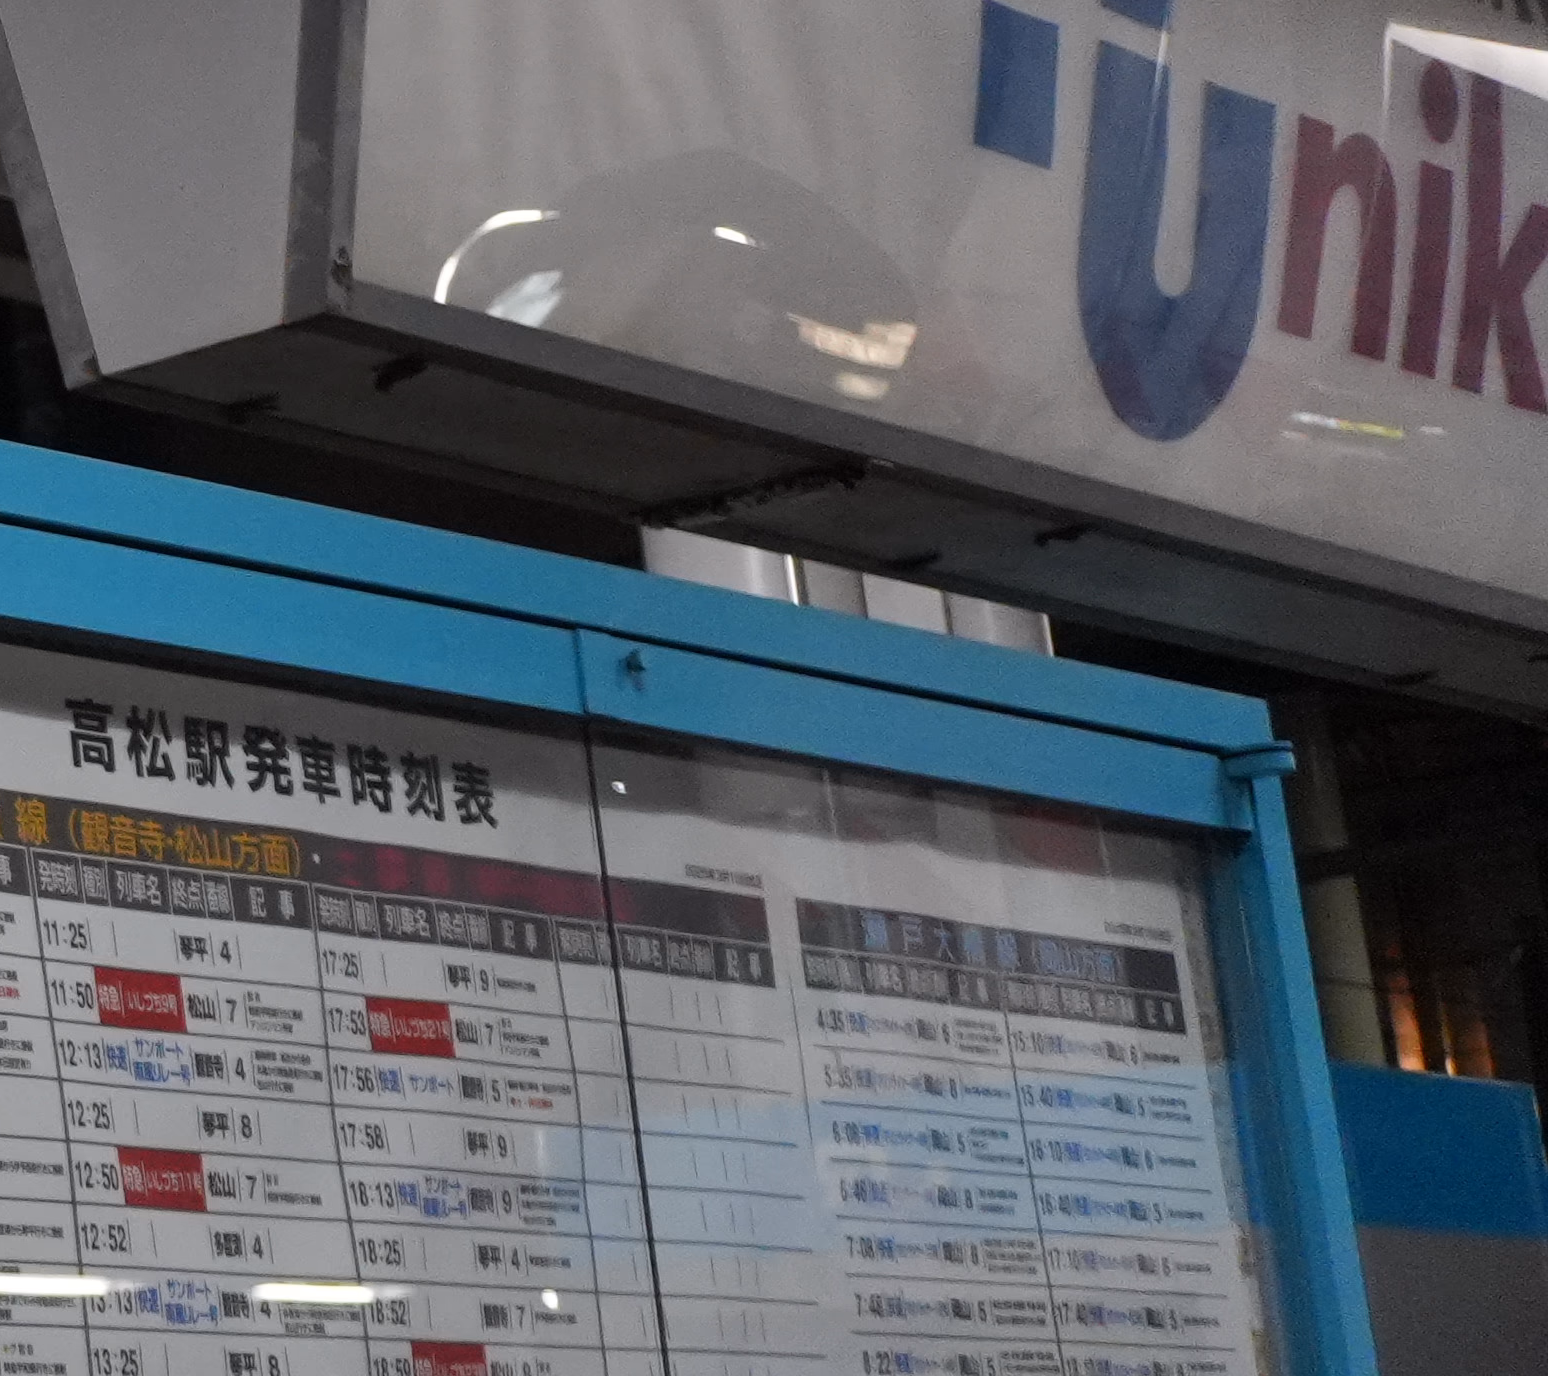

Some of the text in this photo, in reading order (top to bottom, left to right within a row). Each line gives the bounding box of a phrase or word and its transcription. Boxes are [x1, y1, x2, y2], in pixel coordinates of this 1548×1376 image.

[64, 696, 499, 829] 高松駅発車時刻表
